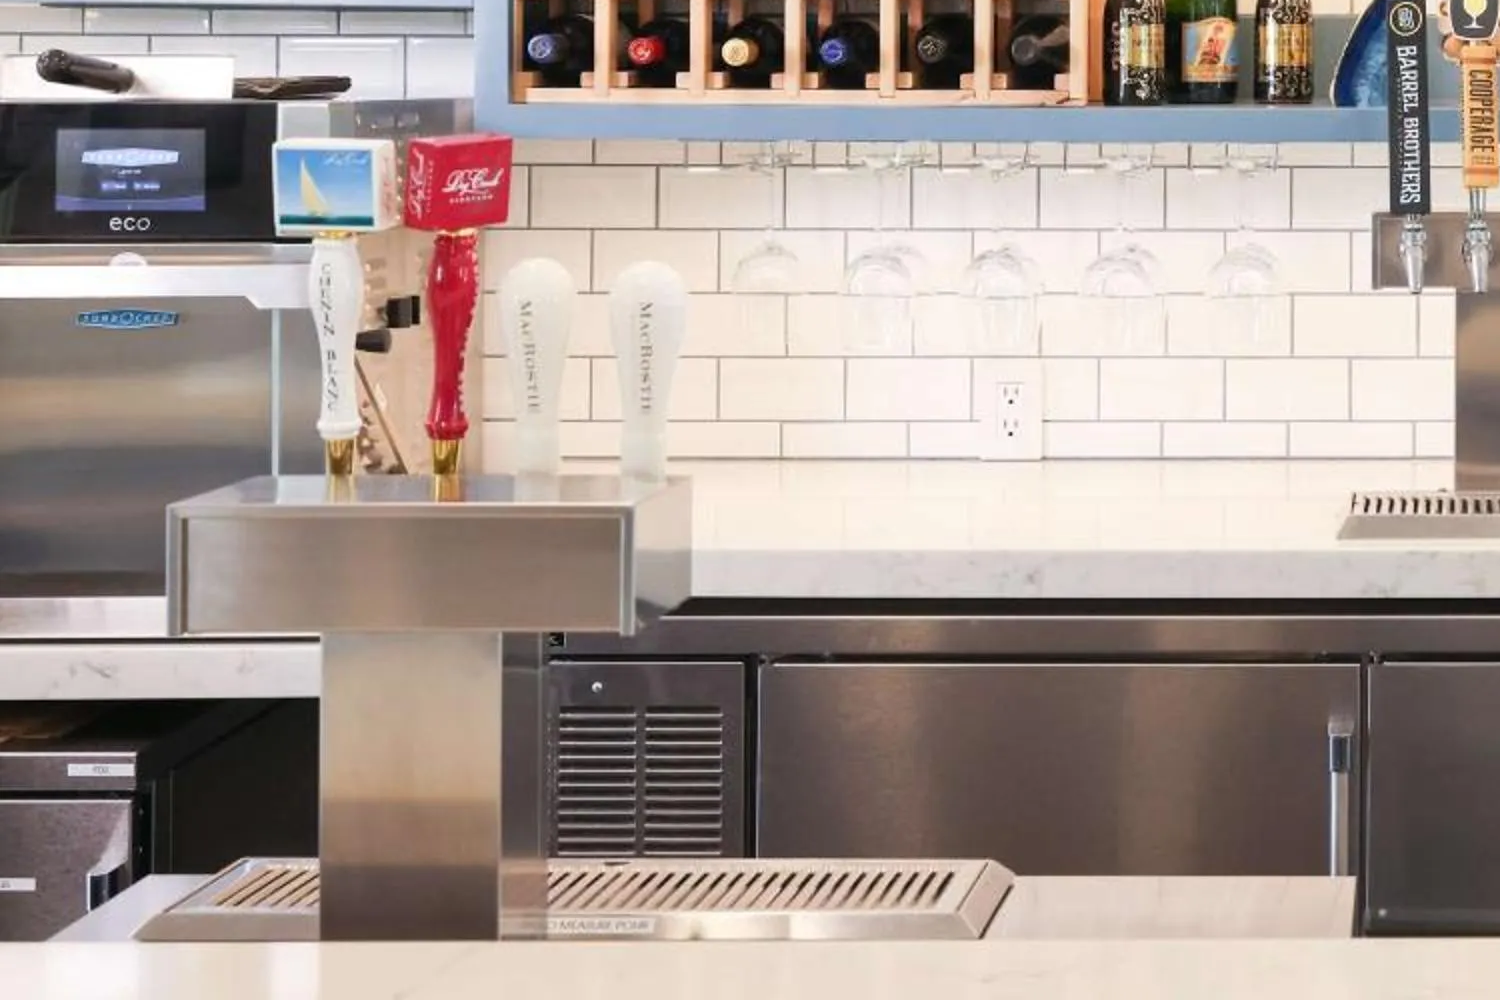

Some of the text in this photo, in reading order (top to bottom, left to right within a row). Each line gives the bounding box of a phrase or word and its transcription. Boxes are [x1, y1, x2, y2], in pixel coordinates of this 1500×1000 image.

[1395, 45, 1418, 113] BARREL
[1469, 69, 1495, 153] COOPERAGE
[1399, 117, 1422, 204] BROTHERS
[109, 217, 151, 231] eco
[327, 350, 338, 411] BLANC
